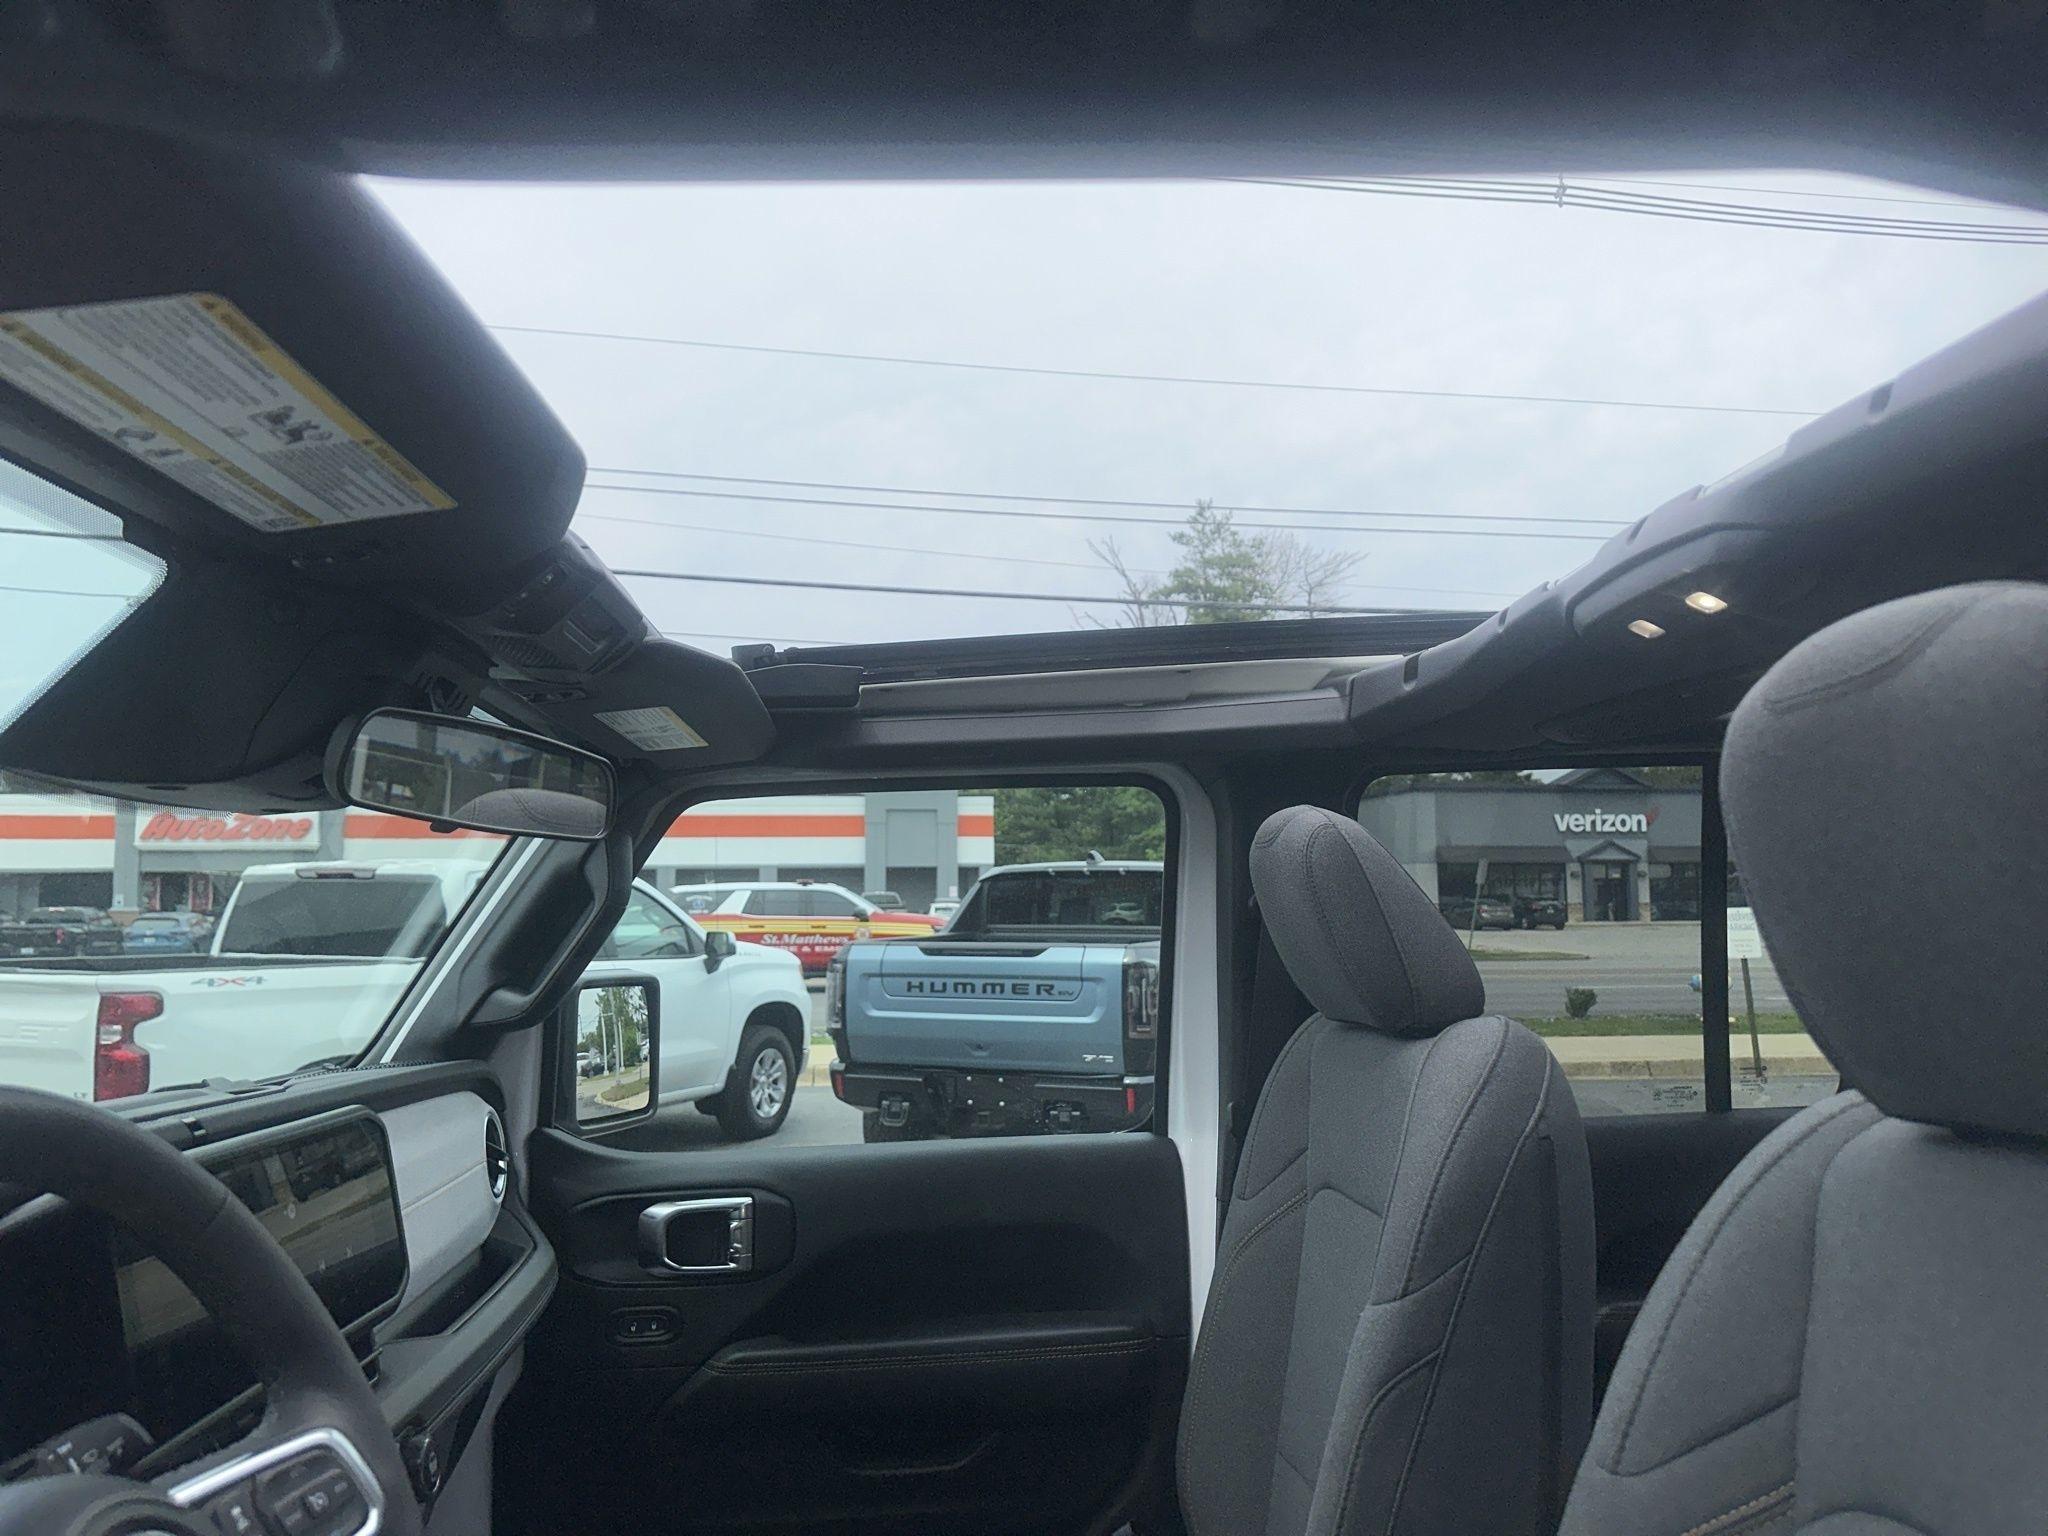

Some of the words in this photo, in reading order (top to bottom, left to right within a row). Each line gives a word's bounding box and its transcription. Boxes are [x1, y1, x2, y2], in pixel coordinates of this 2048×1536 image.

[140, 812, 312, 841] AutoZone
[1553, 808, 1648, 833] verizon
[906, 980, 1057, 997] HUMMER
